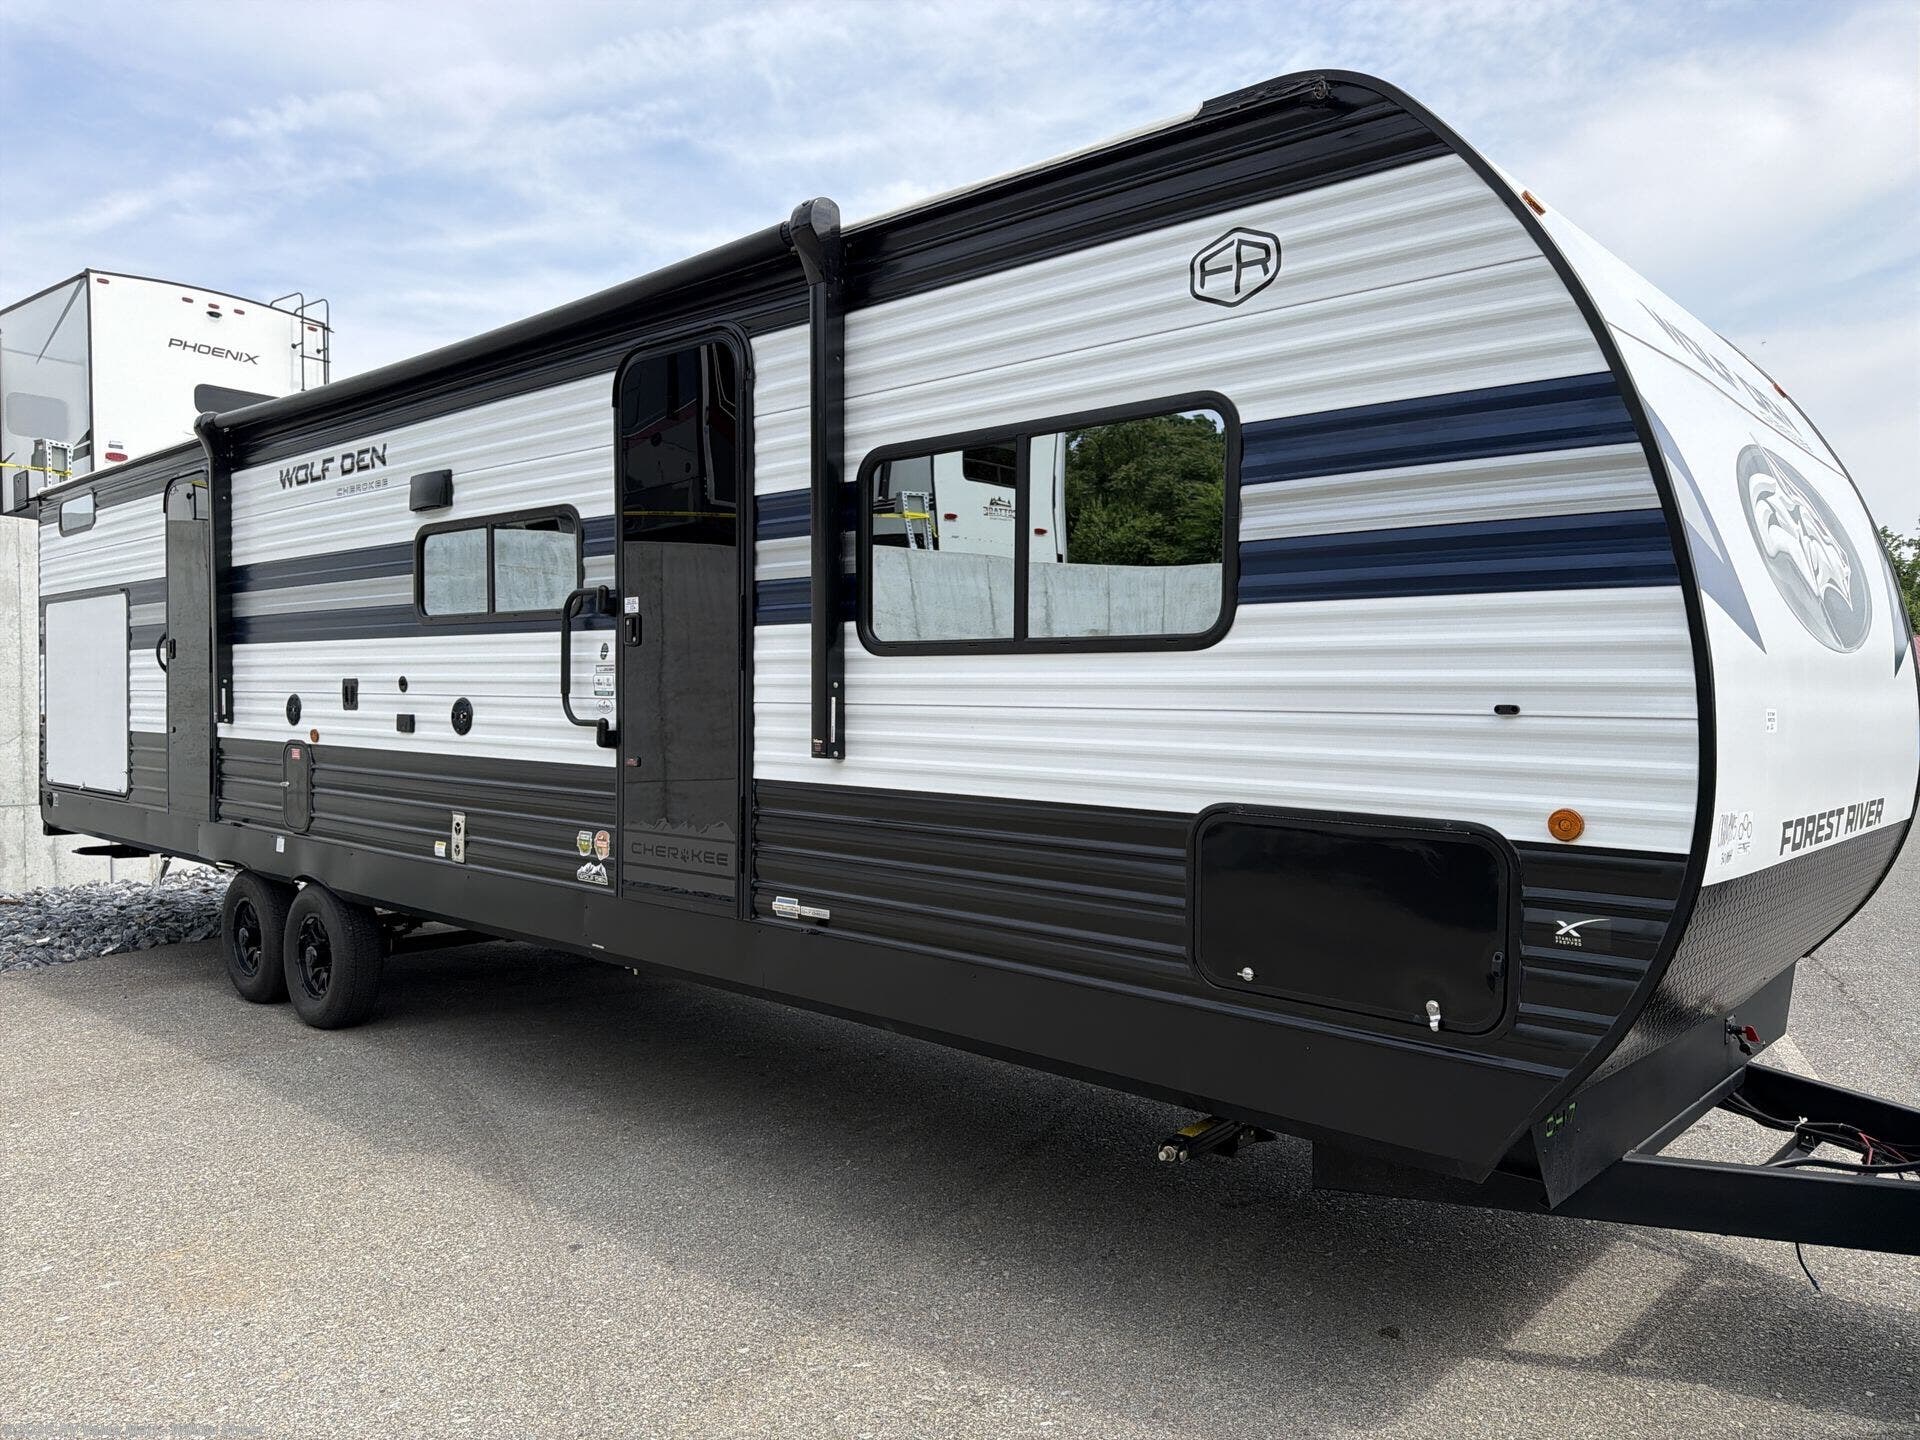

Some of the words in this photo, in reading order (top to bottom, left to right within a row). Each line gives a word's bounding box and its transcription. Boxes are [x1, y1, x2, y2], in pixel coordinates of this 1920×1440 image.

[168, 338, 260, 365] PHOENIX
[280, 456, 335, 490] WOLF
[340, 443, 388, 476] DEN
[336, 478, 388, 496] CHEROKEE
[1779, 807, 1845, 856] FOREST
[1844, 797, 1885, 835] RIVER
